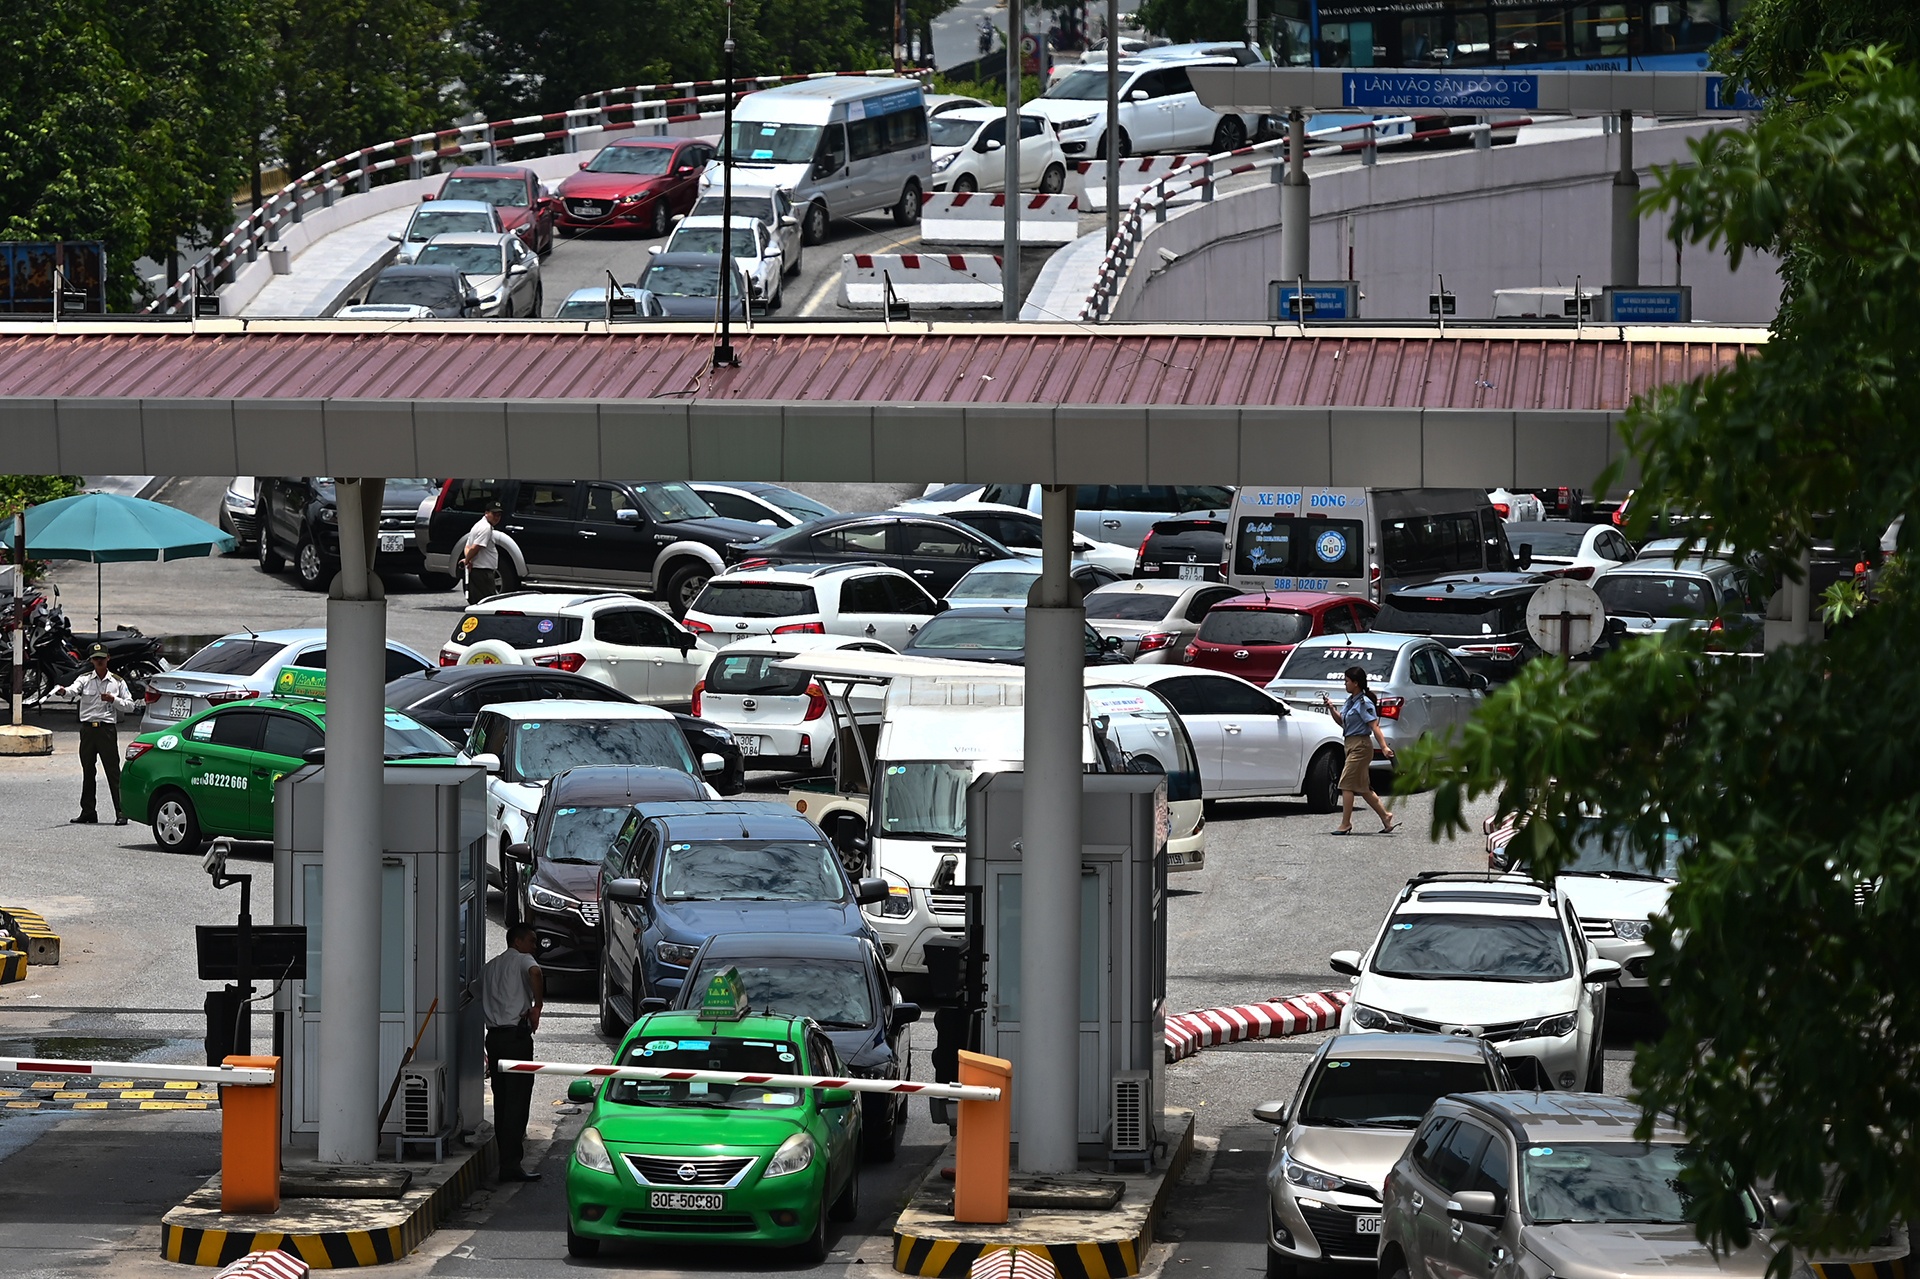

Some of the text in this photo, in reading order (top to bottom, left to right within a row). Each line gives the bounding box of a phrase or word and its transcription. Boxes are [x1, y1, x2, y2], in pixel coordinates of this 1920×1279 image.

[1405, 3, 1415, 11] GA
[1364, 76, 1532, 93] LÀN VÀO SÂN ĐỖ Ô TÔ
[1383, 95, 1511, 106] LANE TO CAR PARKING
[1258, 493, 1274, 506] XE
[1276, 492, 1301, 509] HỢP
[1274, 578, 1291, 590] 98B
[740, 736, 754, 746] 30E
[1358, 1218, 1382, 1232] 30F
